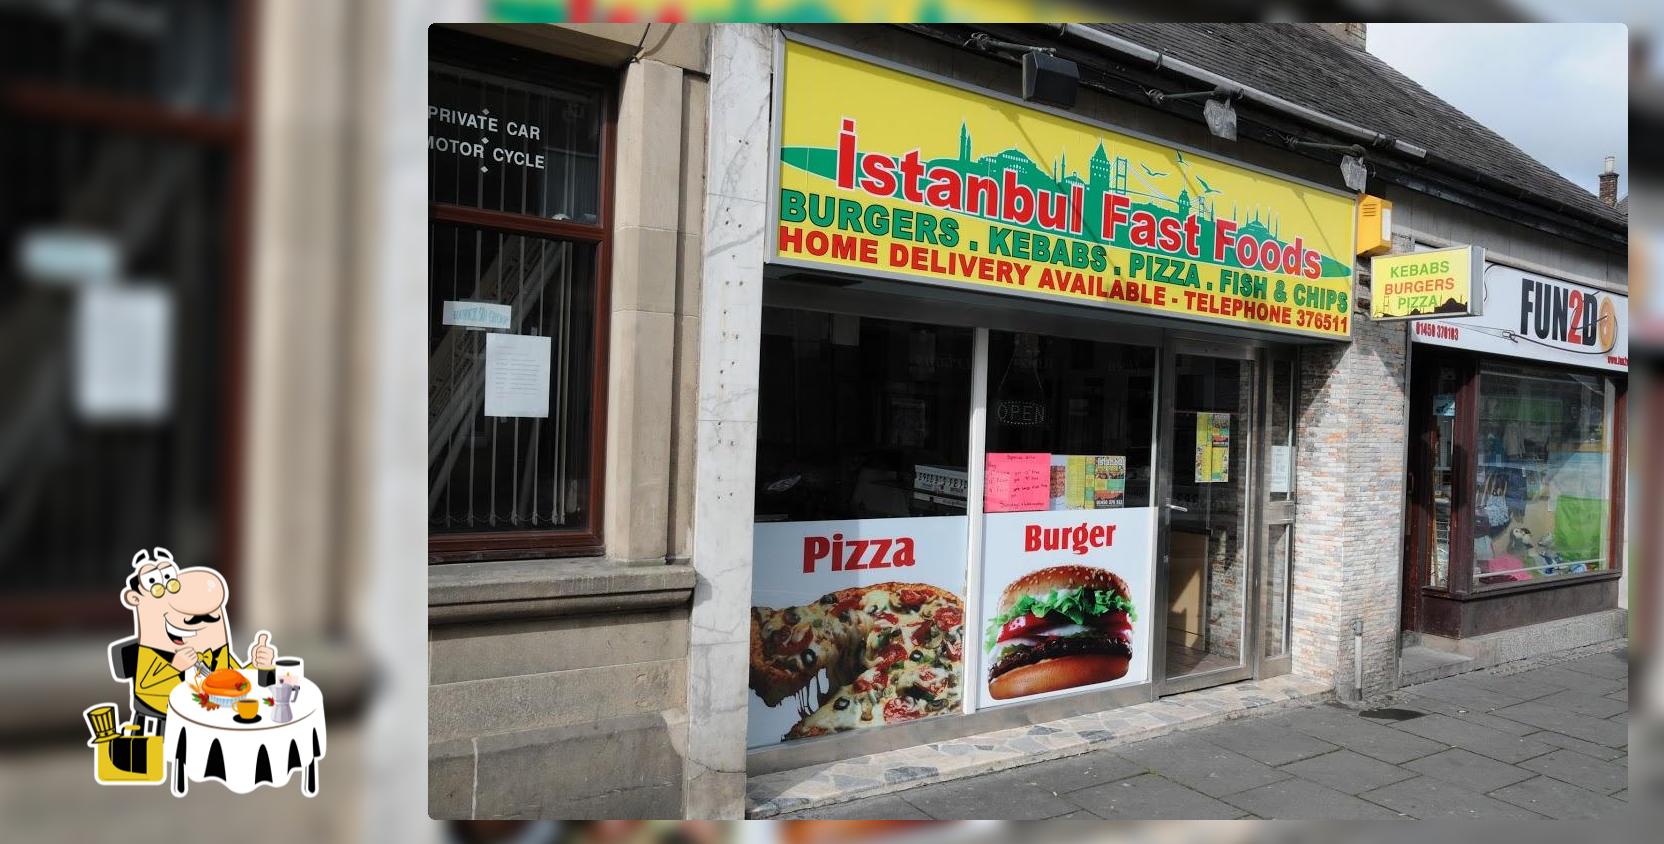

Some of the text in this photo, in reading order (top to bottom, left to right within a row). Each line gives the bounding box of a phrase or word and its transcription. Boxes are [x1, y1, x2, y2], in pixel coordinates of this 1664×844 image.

[428, 105, 540, 140] PRIVATE CAR
[493, 147, 545, 169] CYCLE
[1101, 191, 1202, 257] Fast
[1214, 217, 1323, 280] Foods
[780, 188, 960, 248] BURGERS
[988, 225, 1107, 273] KEBABS
[1129, 253, 1201, 289] PIZZA
[1219, 267, 1267, 300] FISH
[1273, 279, 1288, 303] &
[1293, 286, 1348, 314] CHIPS
[779, 226, 878, 264] HOME
[889, 243, 1031, 289] DELIVERY
[1038, 268, 1166, 306] AVAILABLE
[1184, 291, 1291, 325] TELEPHONE
[1296, 309, 1348, 333] 376511
[1390, 260, 1450, 278] KEBABS
[1384, 277, 1455, 295] BURGERS
[1397, 294, 1438, 309] PIZZA
[997, 403, 1045, 422] OPEN
[802, 522, 1117, 573] Pizza Burger
